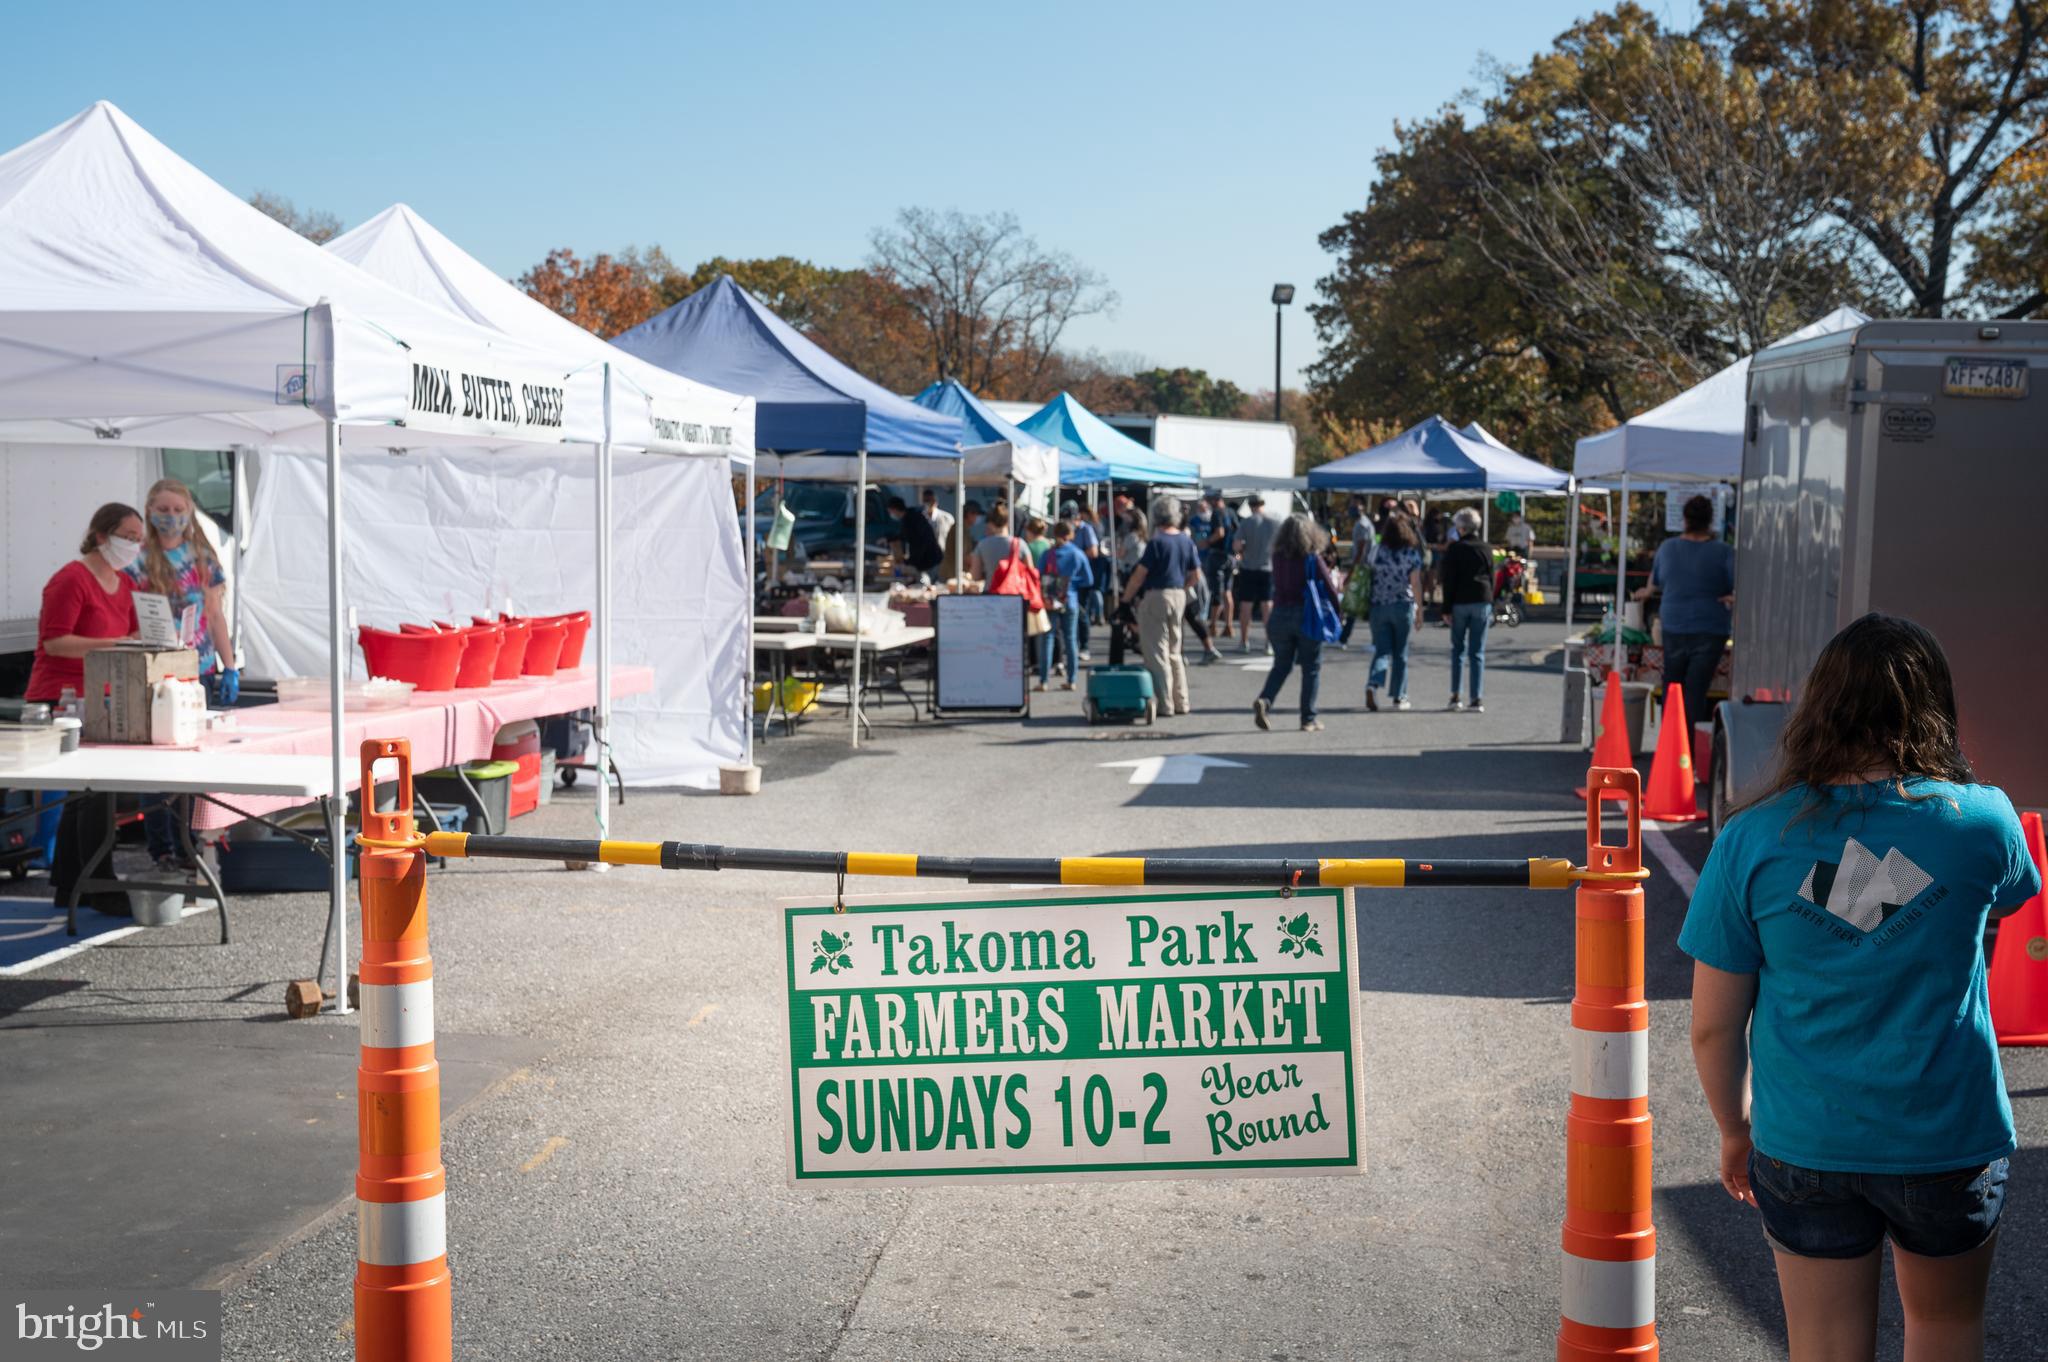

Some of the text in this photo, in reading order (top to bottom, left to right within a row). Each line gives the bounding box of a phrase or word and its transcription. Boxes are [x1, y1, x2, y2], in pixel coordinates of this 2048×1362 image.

[412, 363, 563, 427] MILK, BUTTER, CHEESE
[872, 910, 1258, 976] Takoma Park
[1787, 902, 1863, 948] EARTH TREKS
[1872, 885, 1949, 947] CLIMBING TEAM
[811, 978, 1327, 1060] FARMERS MARKET
[816, 1071, 1171, 1155] SUNDAYS 10-2
[1200, 1062, 1303, 1106] Year
[1206, 1093, 1330, 1155] Round
